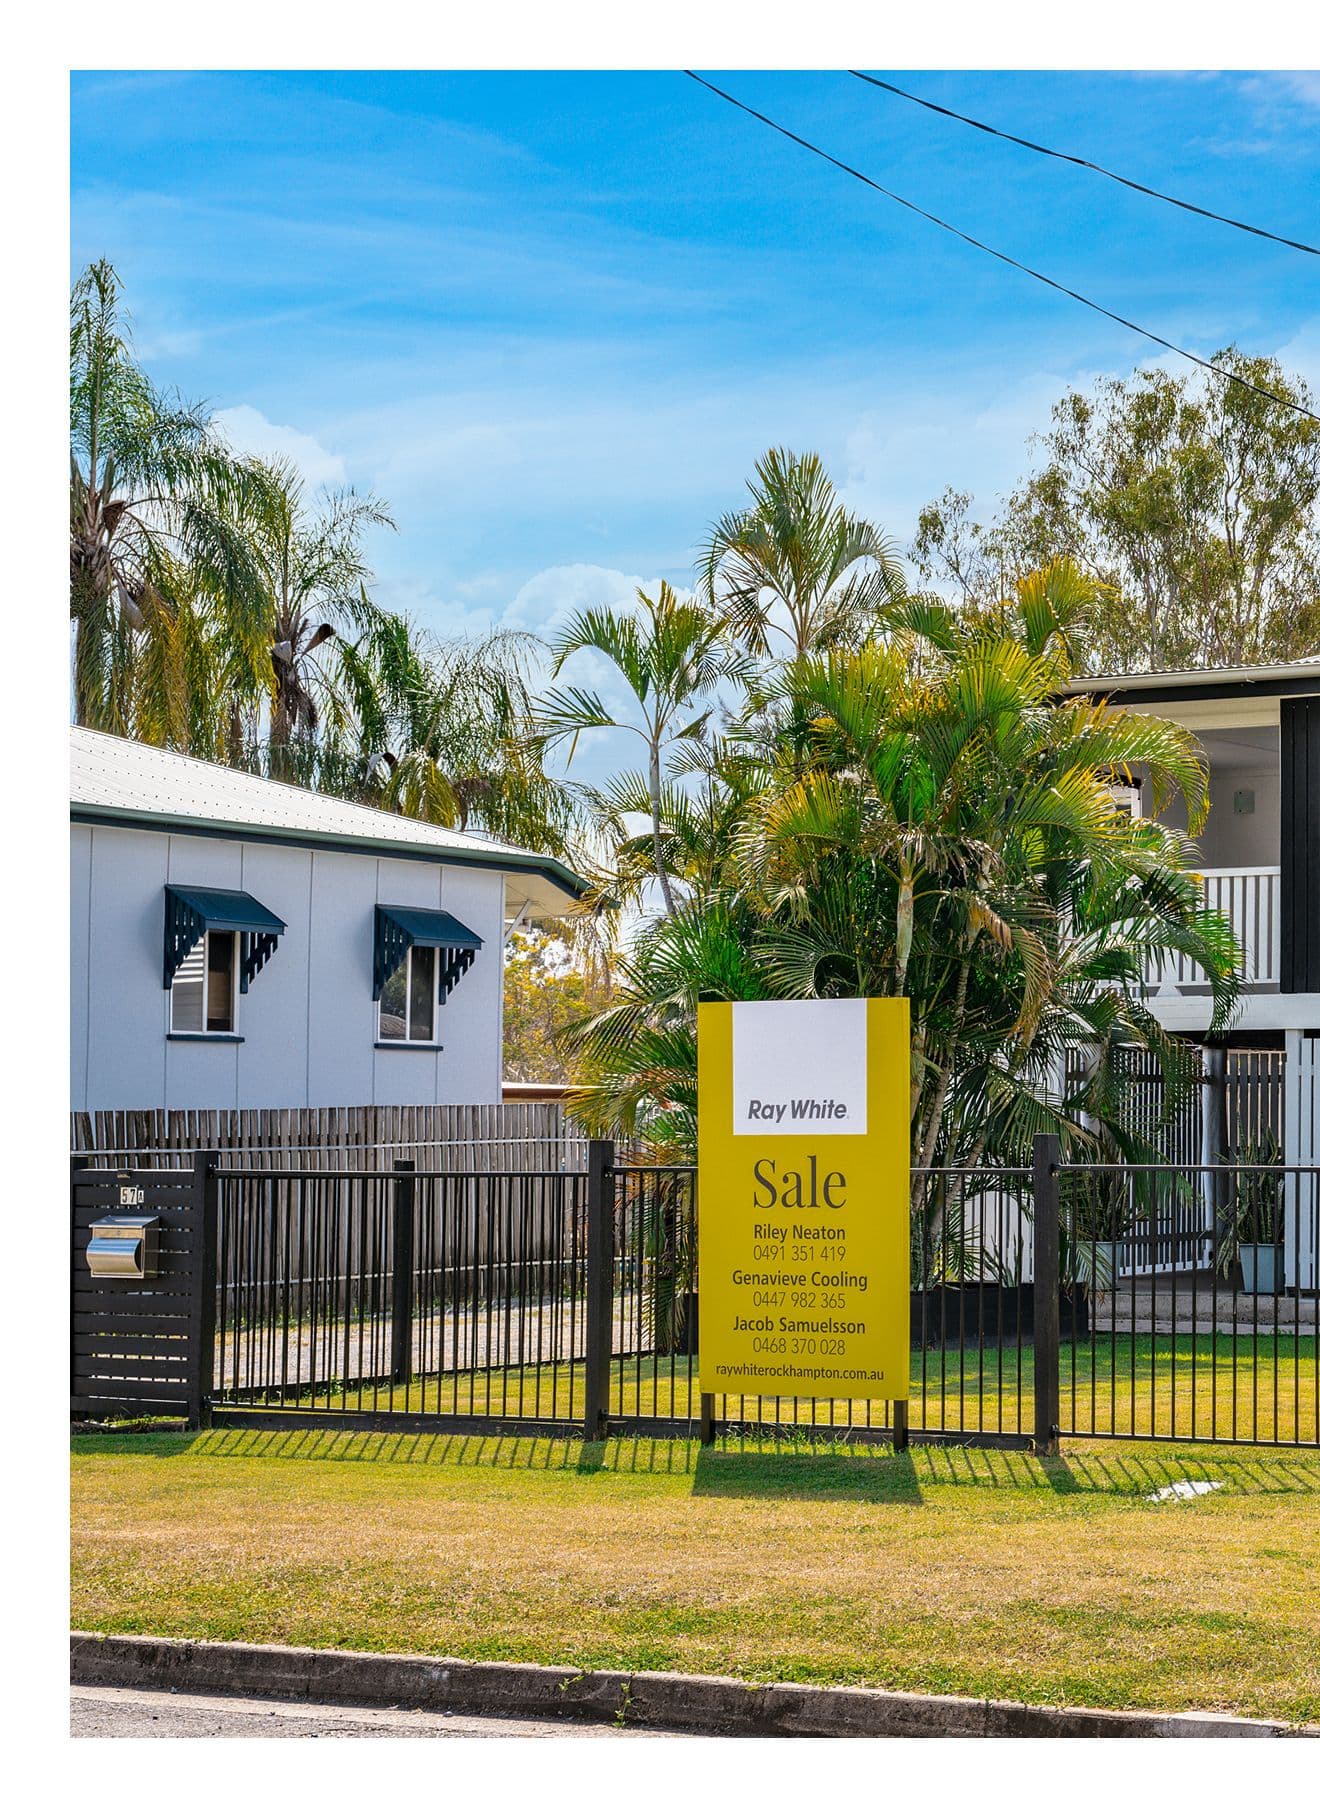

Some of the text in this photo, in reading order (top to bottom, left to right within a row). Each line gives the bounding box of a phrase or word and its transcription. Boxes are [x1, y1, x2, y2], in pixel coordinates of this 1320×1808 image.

[748, 1100, 847, 1123] Ray White
[753, 1155, 847, 1209] Sale
[754, 1224, 846, 1243] Riley Neaton
[753, 1245, 846, 1262] 0491 351 419
[732, 1270, 868, 1291] Genavieve Cooling
[753, 1291, 846, 1309] 0447 982 365
[733, 1316, 866, 1334] Jacob Samuelsson
[753, 1337, 846, 1356] 0468 370 028
[716, 1363, 884, 1381] raywhiterockhampton.com.au
